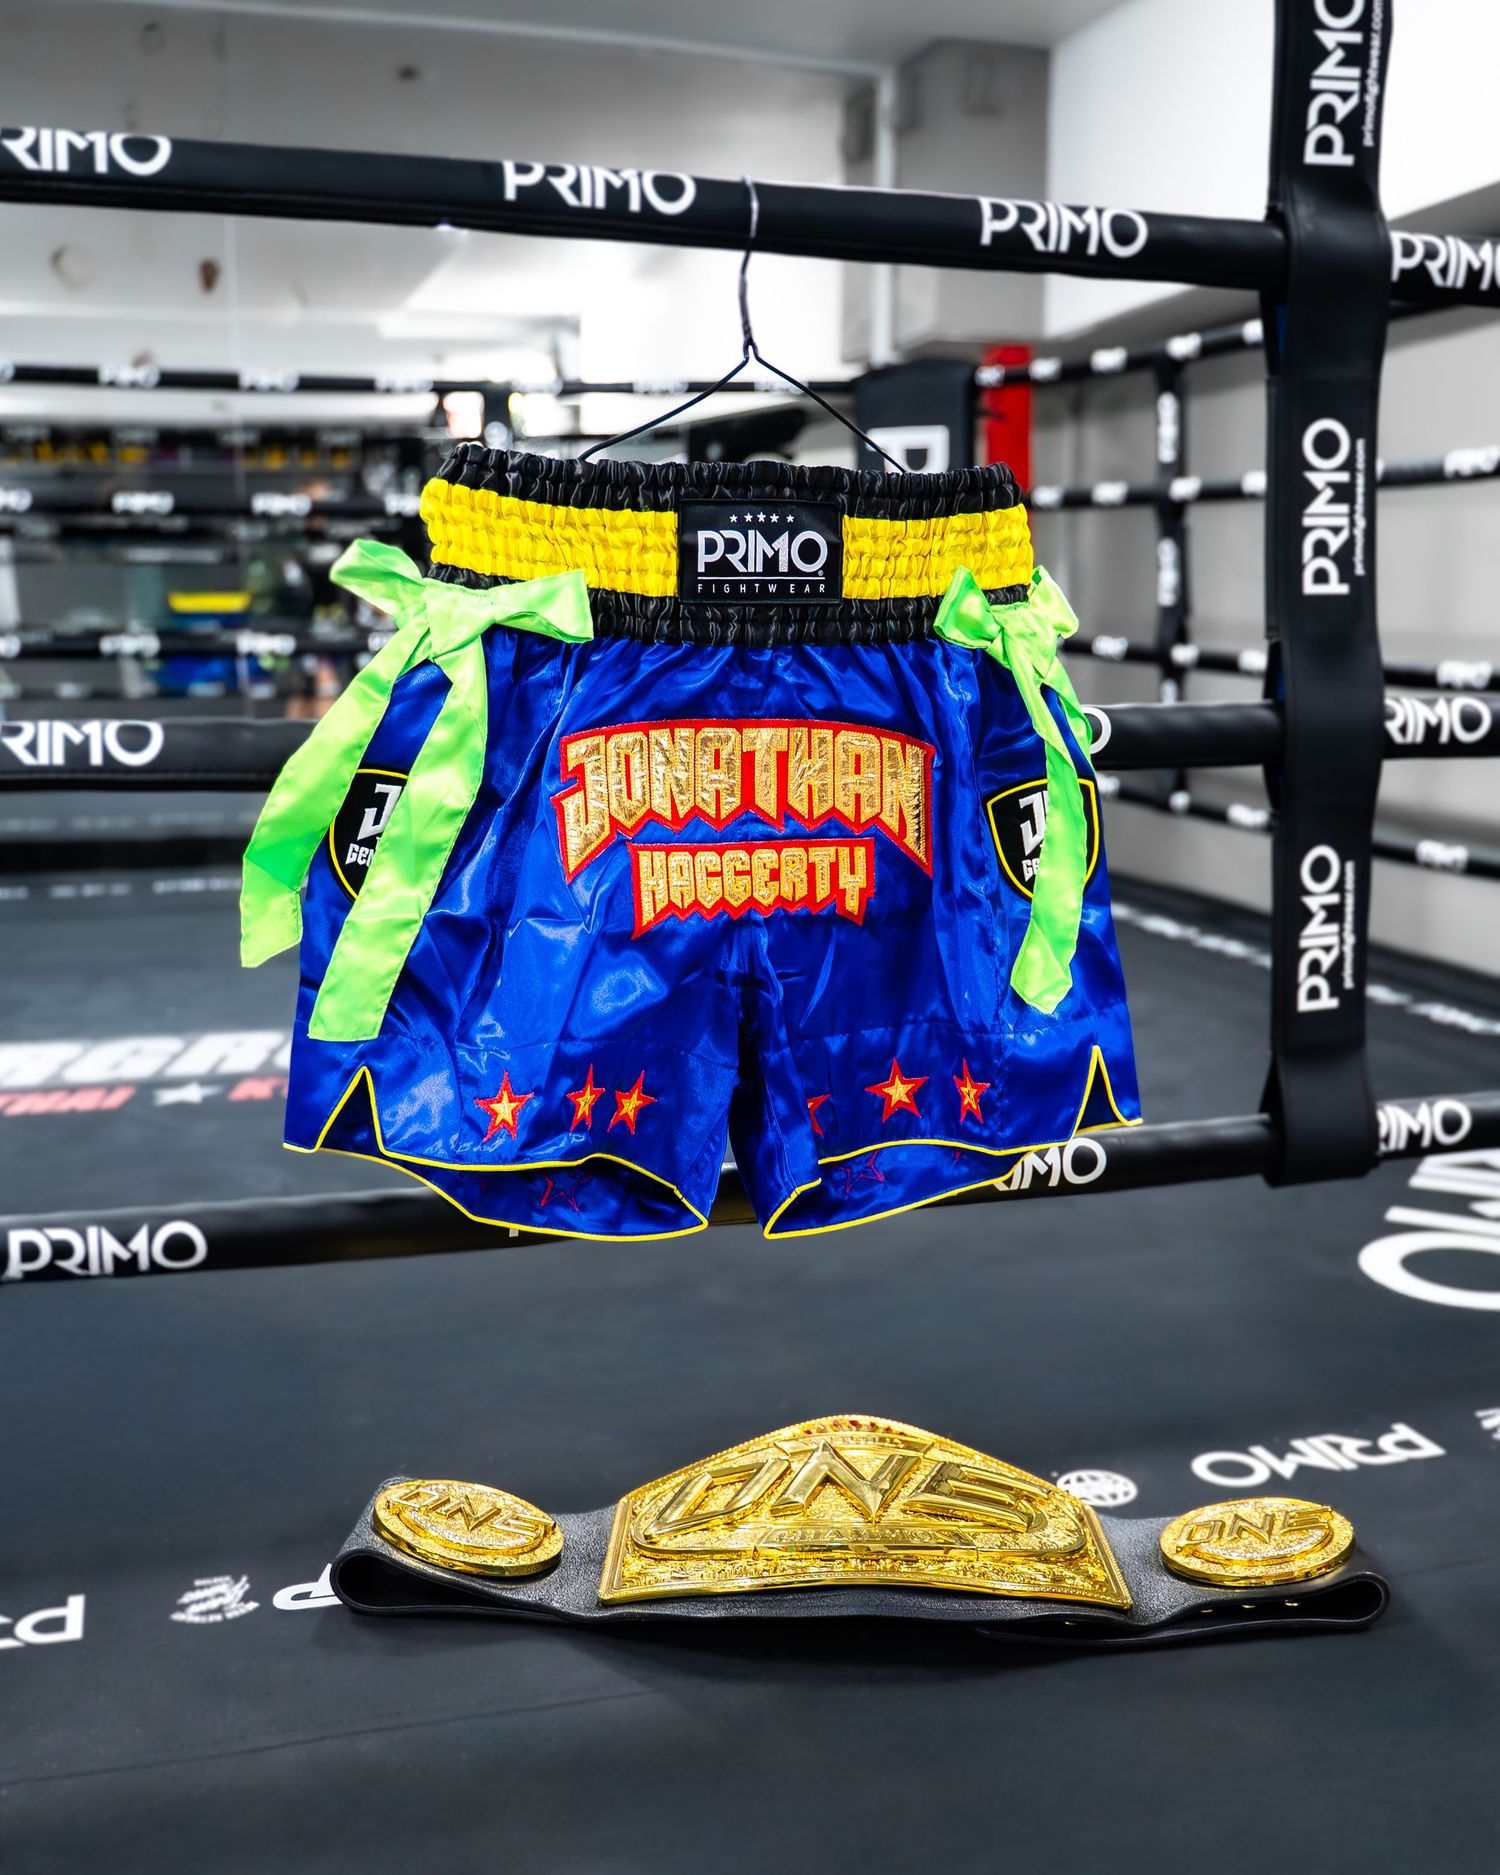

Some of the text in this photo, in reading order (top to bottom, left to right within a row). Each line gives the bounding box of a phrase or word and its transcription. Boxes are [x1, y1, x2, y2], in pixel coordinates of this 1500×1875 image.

[1303, 0, 1365, 167] PRIMO
[0, 126, 172, 176] RIMO
[503, 160, 697, 215] PRIMO
[978, 197, 1149, 259] PRIMO
[1390, 230, 1500, 291] PRIM
[1302, 417, 1351, 595] PRIMO
[697, 529, 828, 573] PRIMO
[698, 583, 826, 594] FIGHTWEAR
[0, 720, 164, 766] RIMO
[1384, 696, 1492, 744] RIMO
[562, 724, 932, 877] JONATHAN
[636, 845, 867, 928] HAGGERTY
[1297, 844, 1341, 1012] PRIMO
[1376, 1099, 1471, 1154] IMO
[993, 1137, 1107, 1191] IMO
[2, 1220, 208, 1281] PRIMO
[1191, 1422, 1446, 1487] PRIMO
[386, 1486, 557, 1539] ONE
[643, 1440, 1050, 1544] ONE
[1175, 1505, 1333, 1553] ONE
